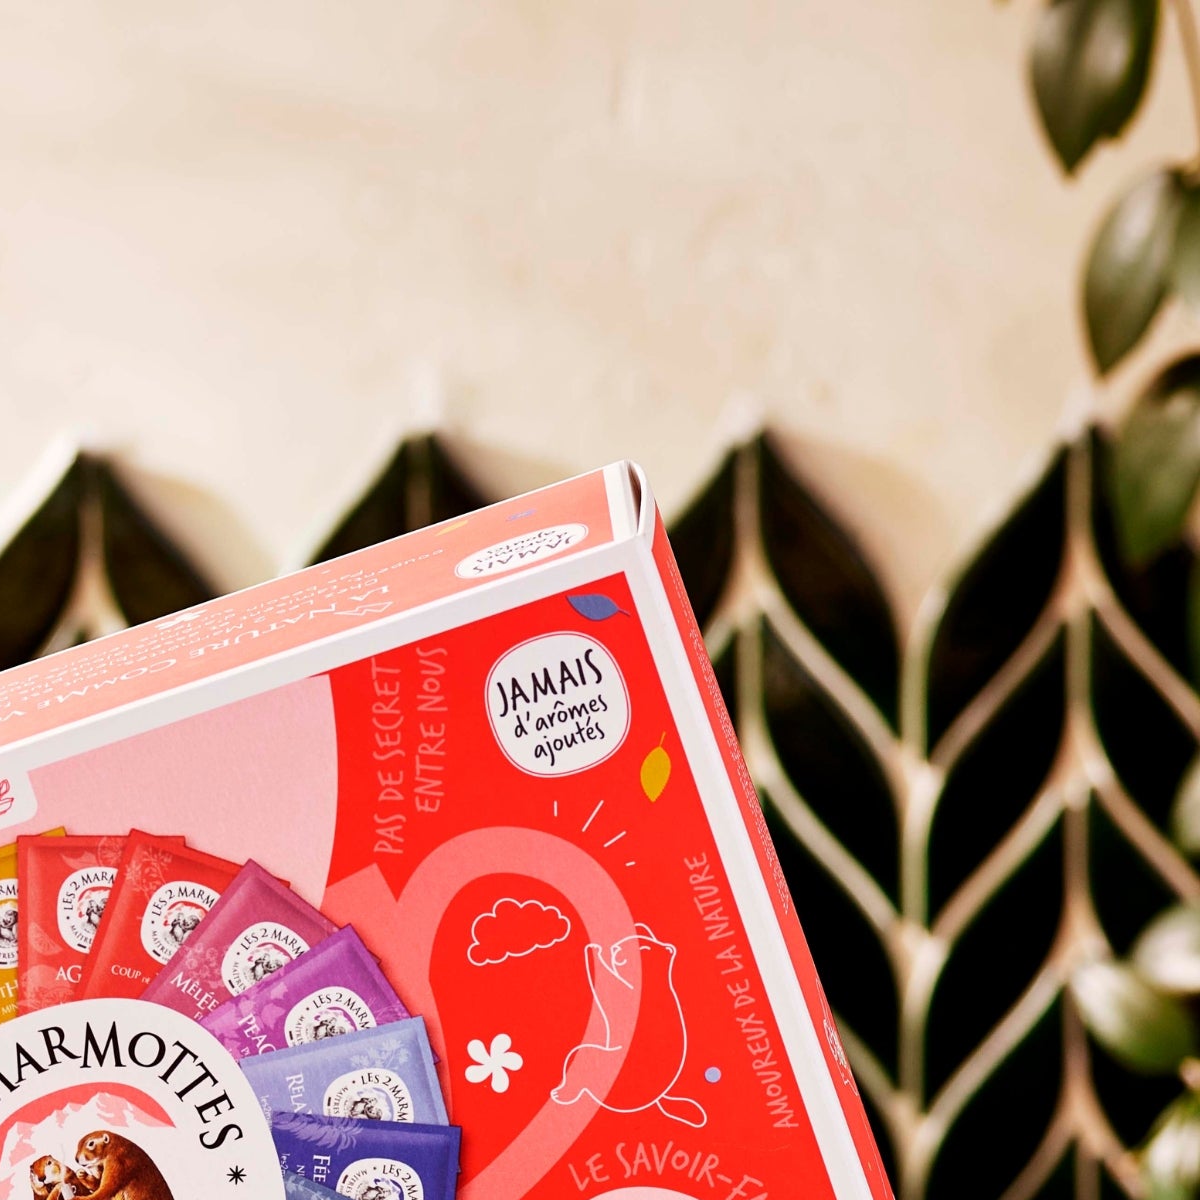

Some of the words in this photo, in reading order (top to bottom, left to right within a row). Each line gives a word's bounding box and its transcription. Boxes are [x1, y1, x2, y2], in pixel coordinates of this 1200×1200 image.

[472, 534, 575, 574] JAMAIS
[346, 584, 389, 606] LA
[415, 645, 448, 714] NOUS
[496, 648, 603, 718] JAMAIS
[371, 655, 405, 764] SECRET
[513, 694, 609, 739] d'arômes
[533, 720, 606, 767] ajoutés
[378, 770, 405, 804] DE
[414, 720, 447, 815] ENTRE
[372, 812, 406, 856] PAS
[683, 851, 736, 942] NATURE
[110, 963, 143, 981] COUP
[716, 943, 744, 976] LA
[169, 971, 220, 1013] MÊLÉE
[727, 977, 757, 1008] DE
[736, 1012, 799, 1129] AMOUREUX
[567, 1153, 610, 1192] LE
